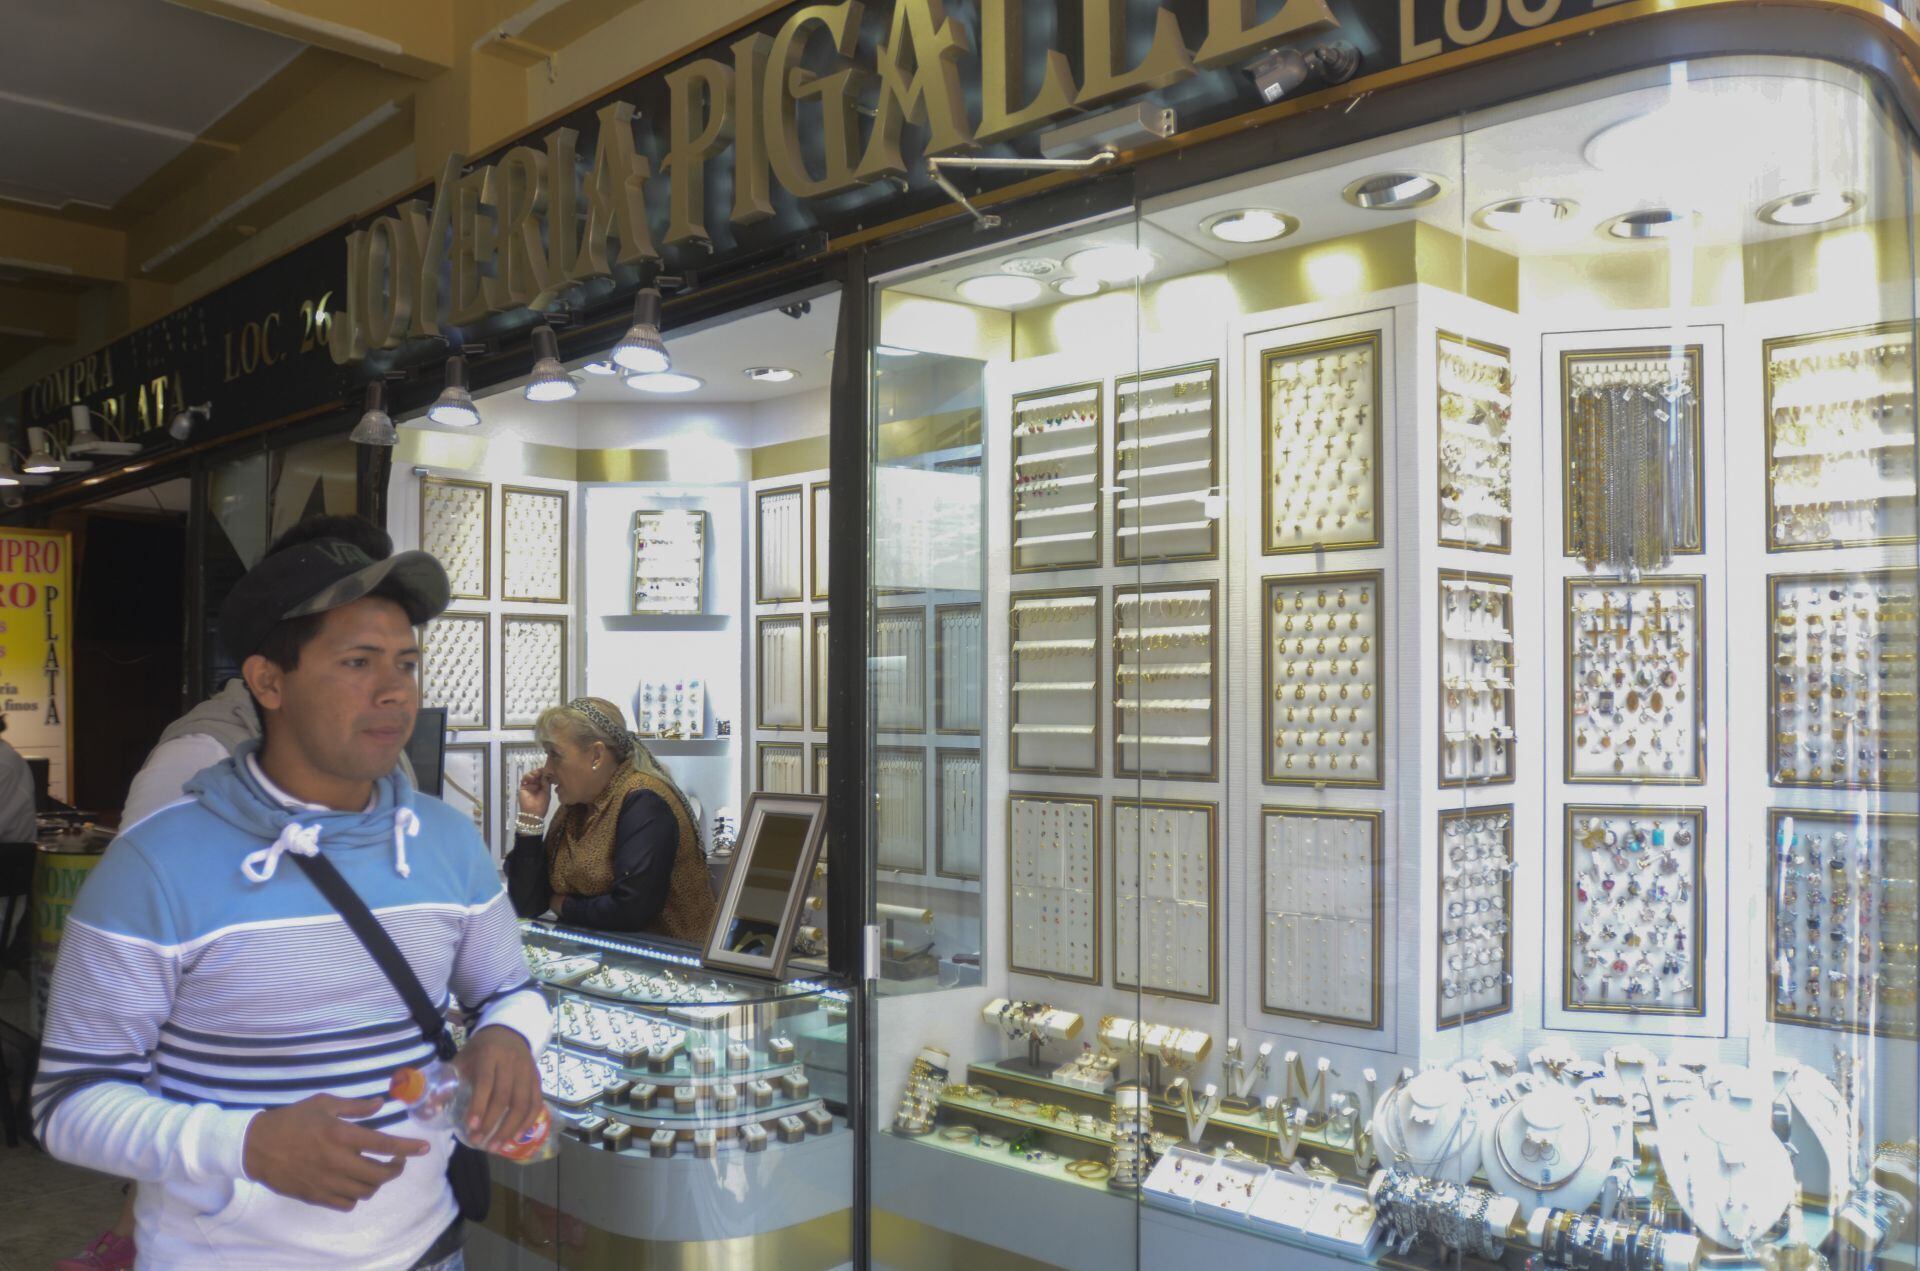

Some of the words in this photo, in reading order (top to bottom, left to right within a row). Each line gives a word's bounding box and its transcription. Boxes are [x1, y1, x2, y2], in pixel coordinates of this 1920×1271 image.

[660, 0, 1341, 245] PIGAL
[299, 290, 334, 354] 26
[30, 346, 113, 420] COMPRA
[101, 368, 185, 441] PLATA
[0, 539, 60, 574] PRO
[43, 585, 61, 726] PLATA
